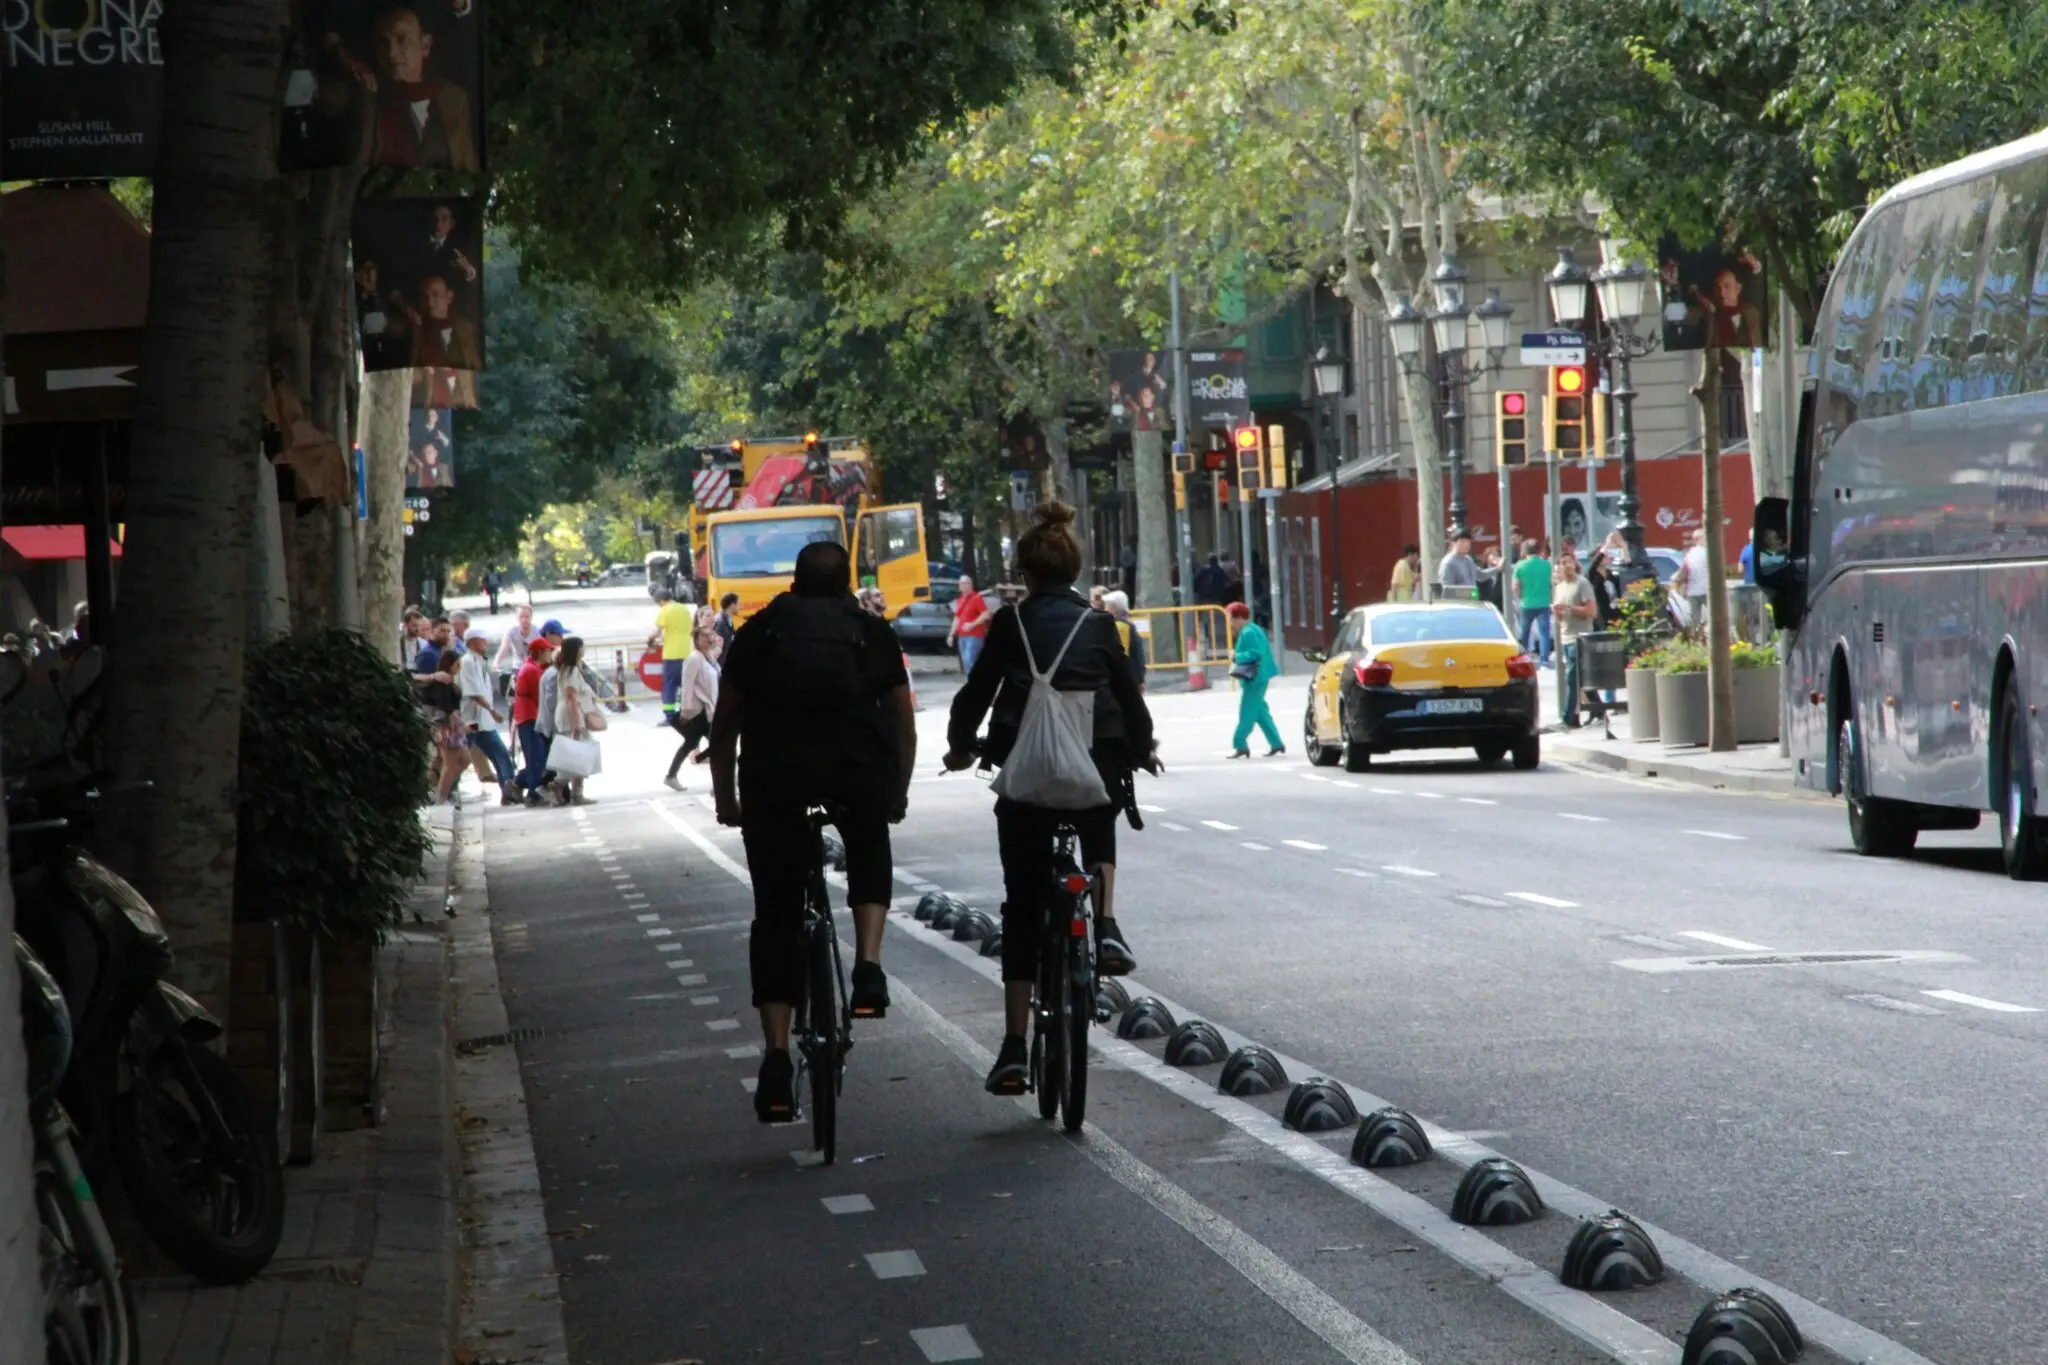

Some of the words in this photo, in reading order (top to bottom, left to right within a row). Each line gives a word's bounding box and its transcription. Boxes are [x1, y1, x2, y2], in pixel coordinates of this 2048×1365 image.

[9, 26, 165, 67] NEGRE
[38, 120, 82, 134] SUSAN
[85, 119, 114, 131] HILL
[8, 136, 64, 150] STEPHEN
[1200, 373, 1247, 390] DONA
[1202, 387, 1246, 399] NEGRE
